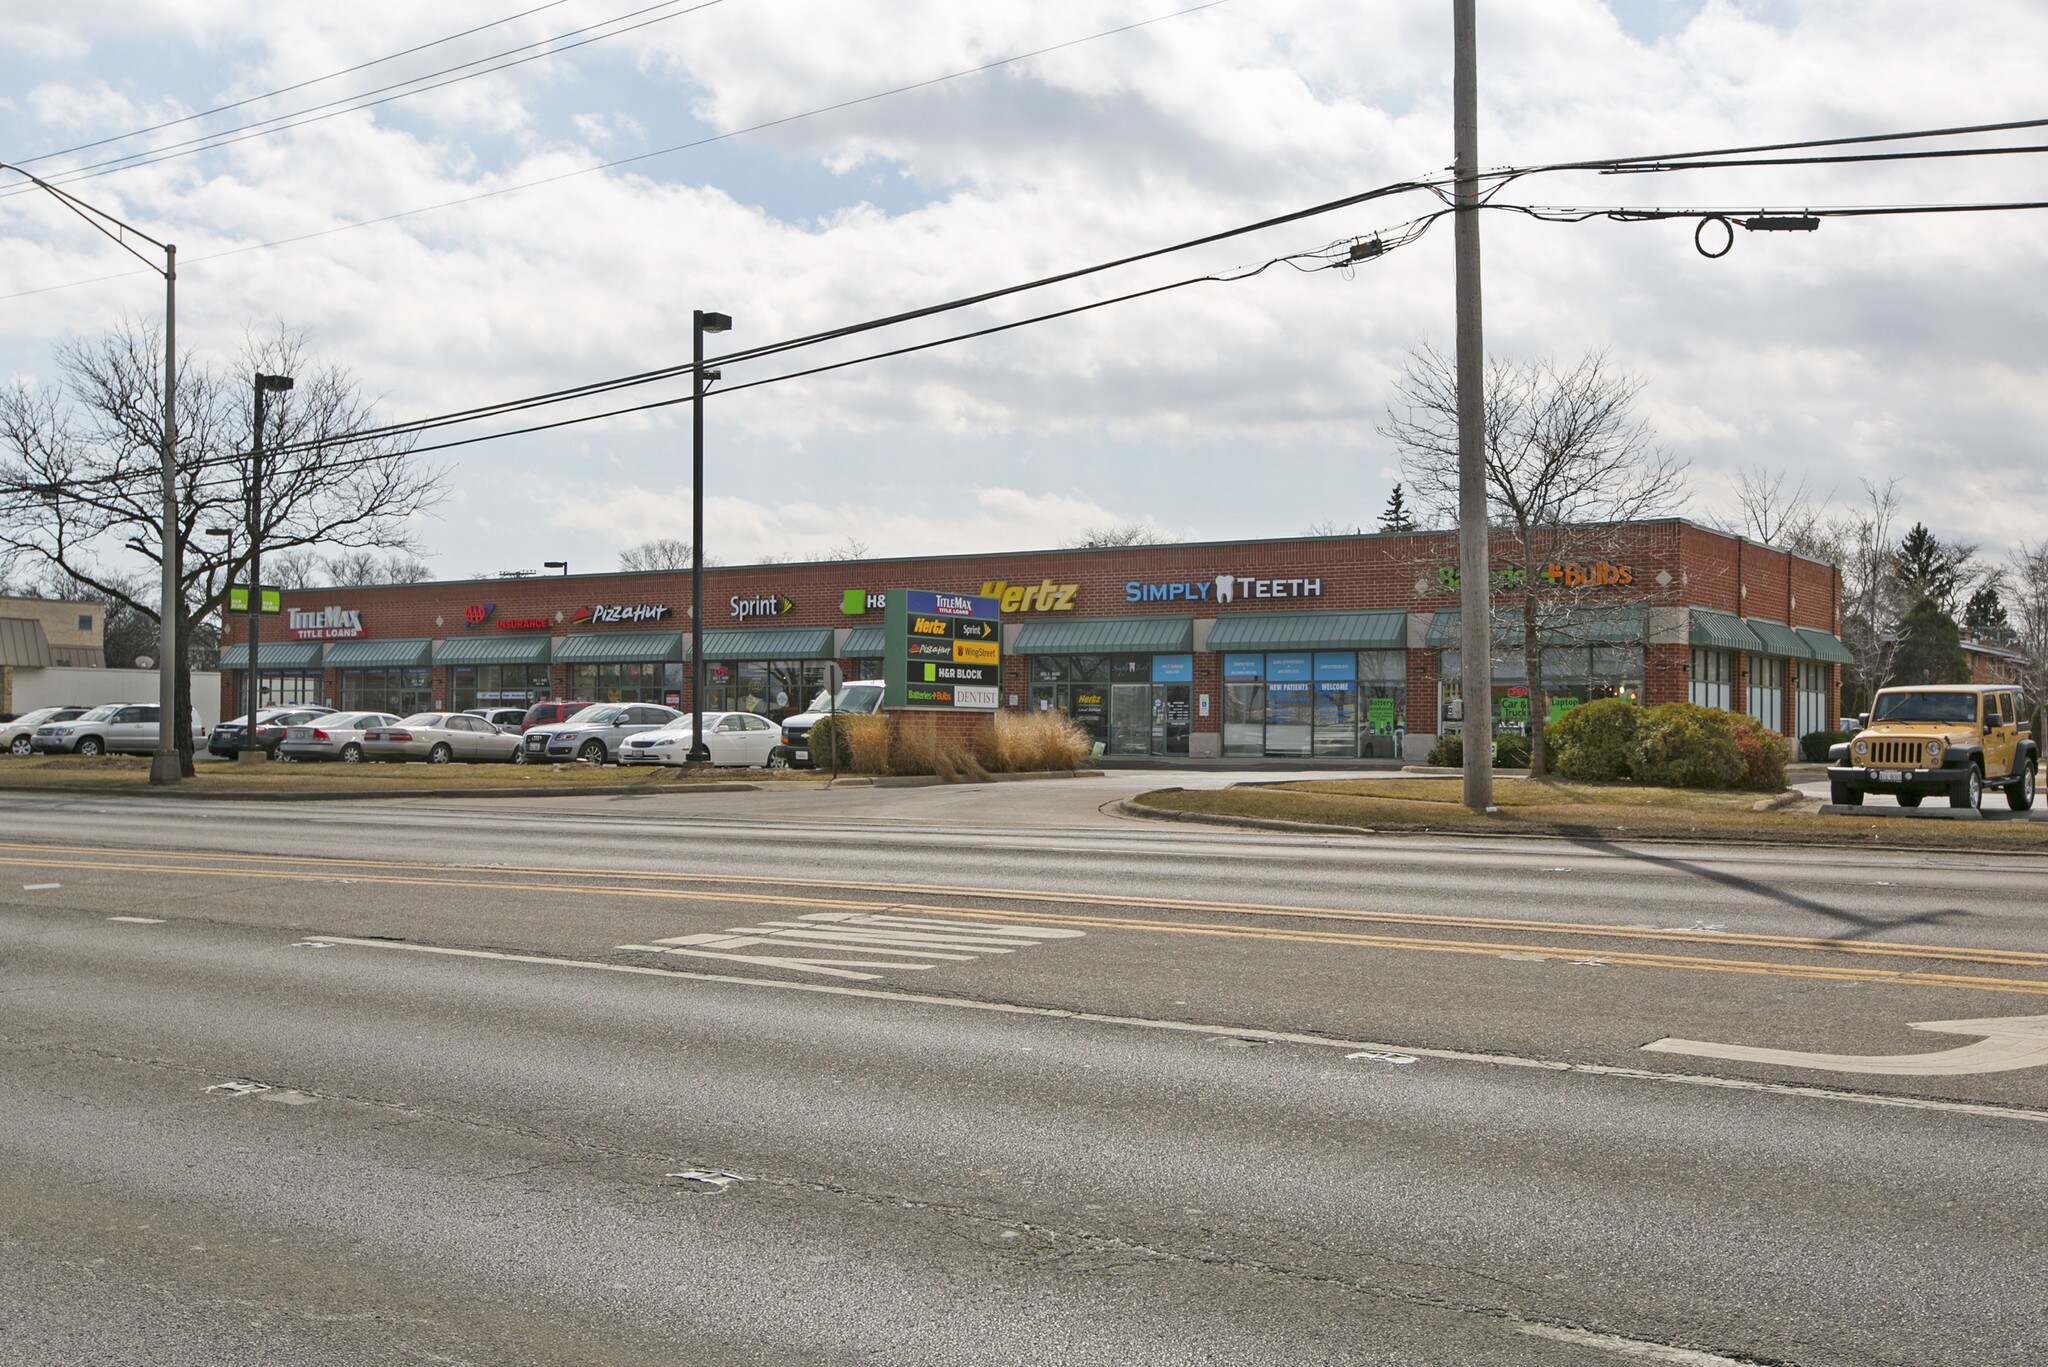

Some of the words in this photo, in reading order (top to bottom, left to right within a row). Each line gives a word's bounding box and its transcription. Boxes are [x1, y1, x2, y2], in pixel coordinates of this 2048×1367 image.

[1125, 581, 1211, 602] SIMPLY
[1237, 577, 1321, 598] TEETH
[867, 594, 885, 608] H&
[980, 579, 1080, 613] Hertz
[730, 595, 777, 622] Sprint
[936, 595, 972, 610] TITLEMAX
[496, 618, 547, 629] INSURANCE
[914, 618, 947, 635] Hertz
[298, 630, 322, 638] TITLE
[326, 629, 357, 637] LOANS
[963, 624, 981, 636] Sprint
[965, 648, 995, 658] WingStreet
[938, 667, 955, 678] H&R
[956, 668, 982, 679] BLOCK
[1283, 683, 1308, 691] PATIENTS
[957, 691, 996, 703] DENTIST
[1078, 694, 1102, 703] Hertz
[1552, 699, 1577, 707] Laptop
[1502, 699, 1518, 708] Car
